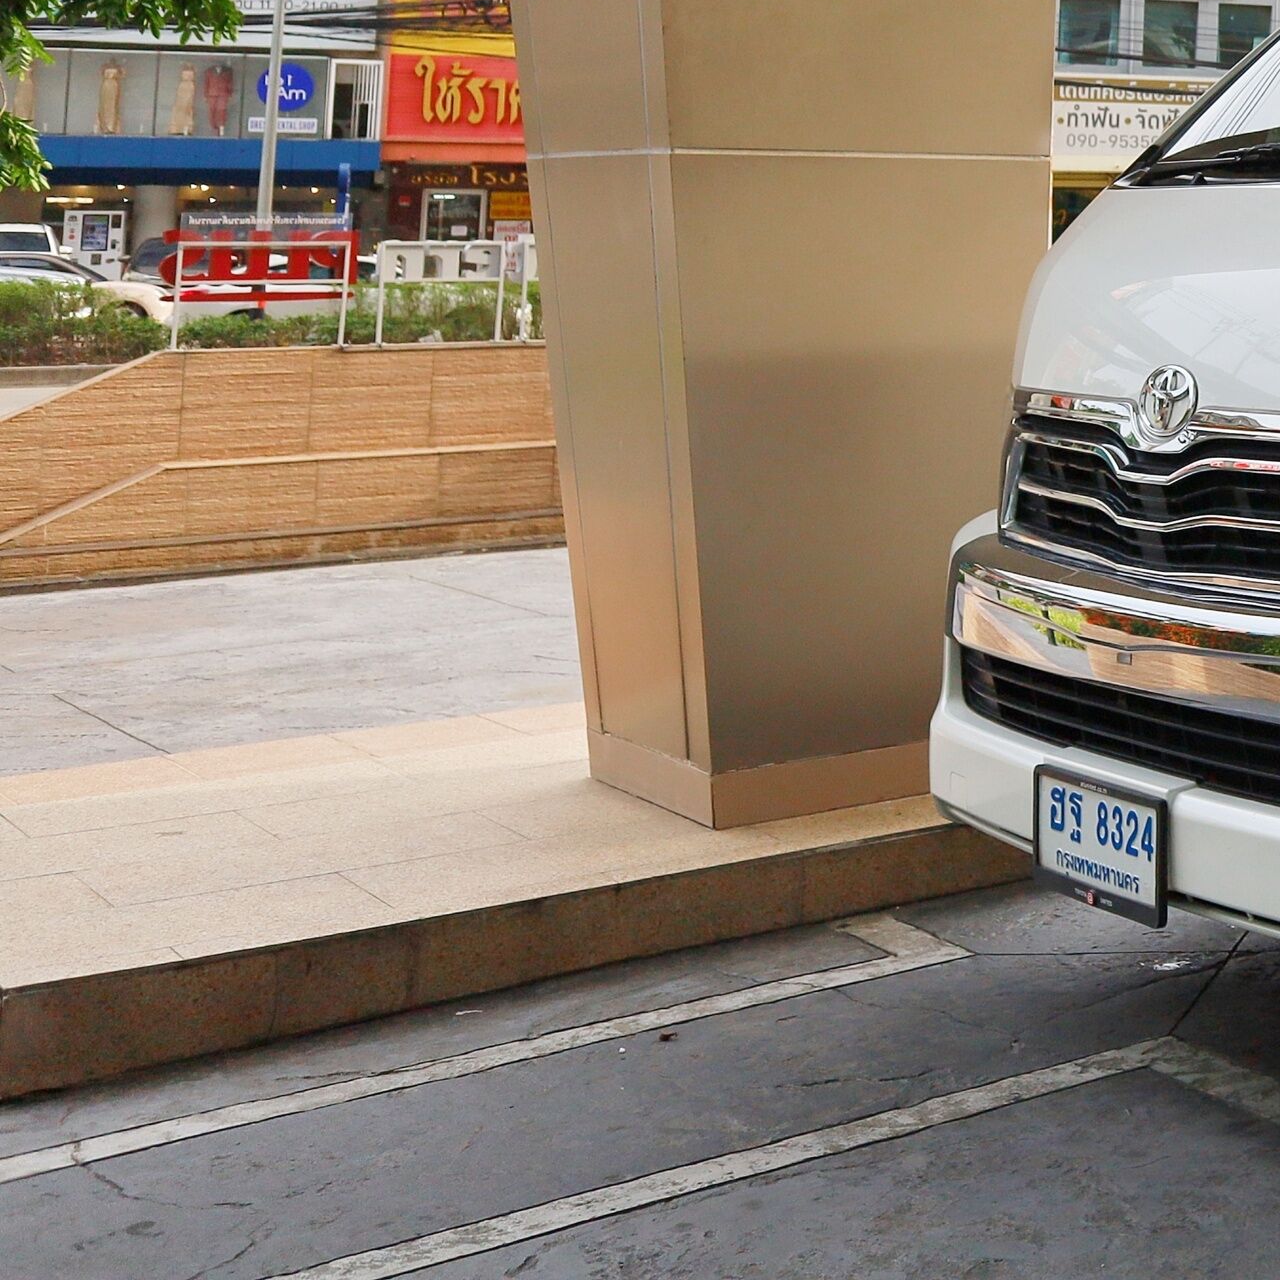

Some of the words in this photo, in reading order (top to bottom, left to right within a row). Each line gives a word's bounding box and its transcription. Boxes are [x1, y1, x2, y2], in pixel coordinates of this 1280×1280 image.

[1066, 104, 1120, 129] ทำฟัน
[1096, 800, 1155, 862] 8324
[1055, 847, 1140, 894] กรุงเทพมหานคร
